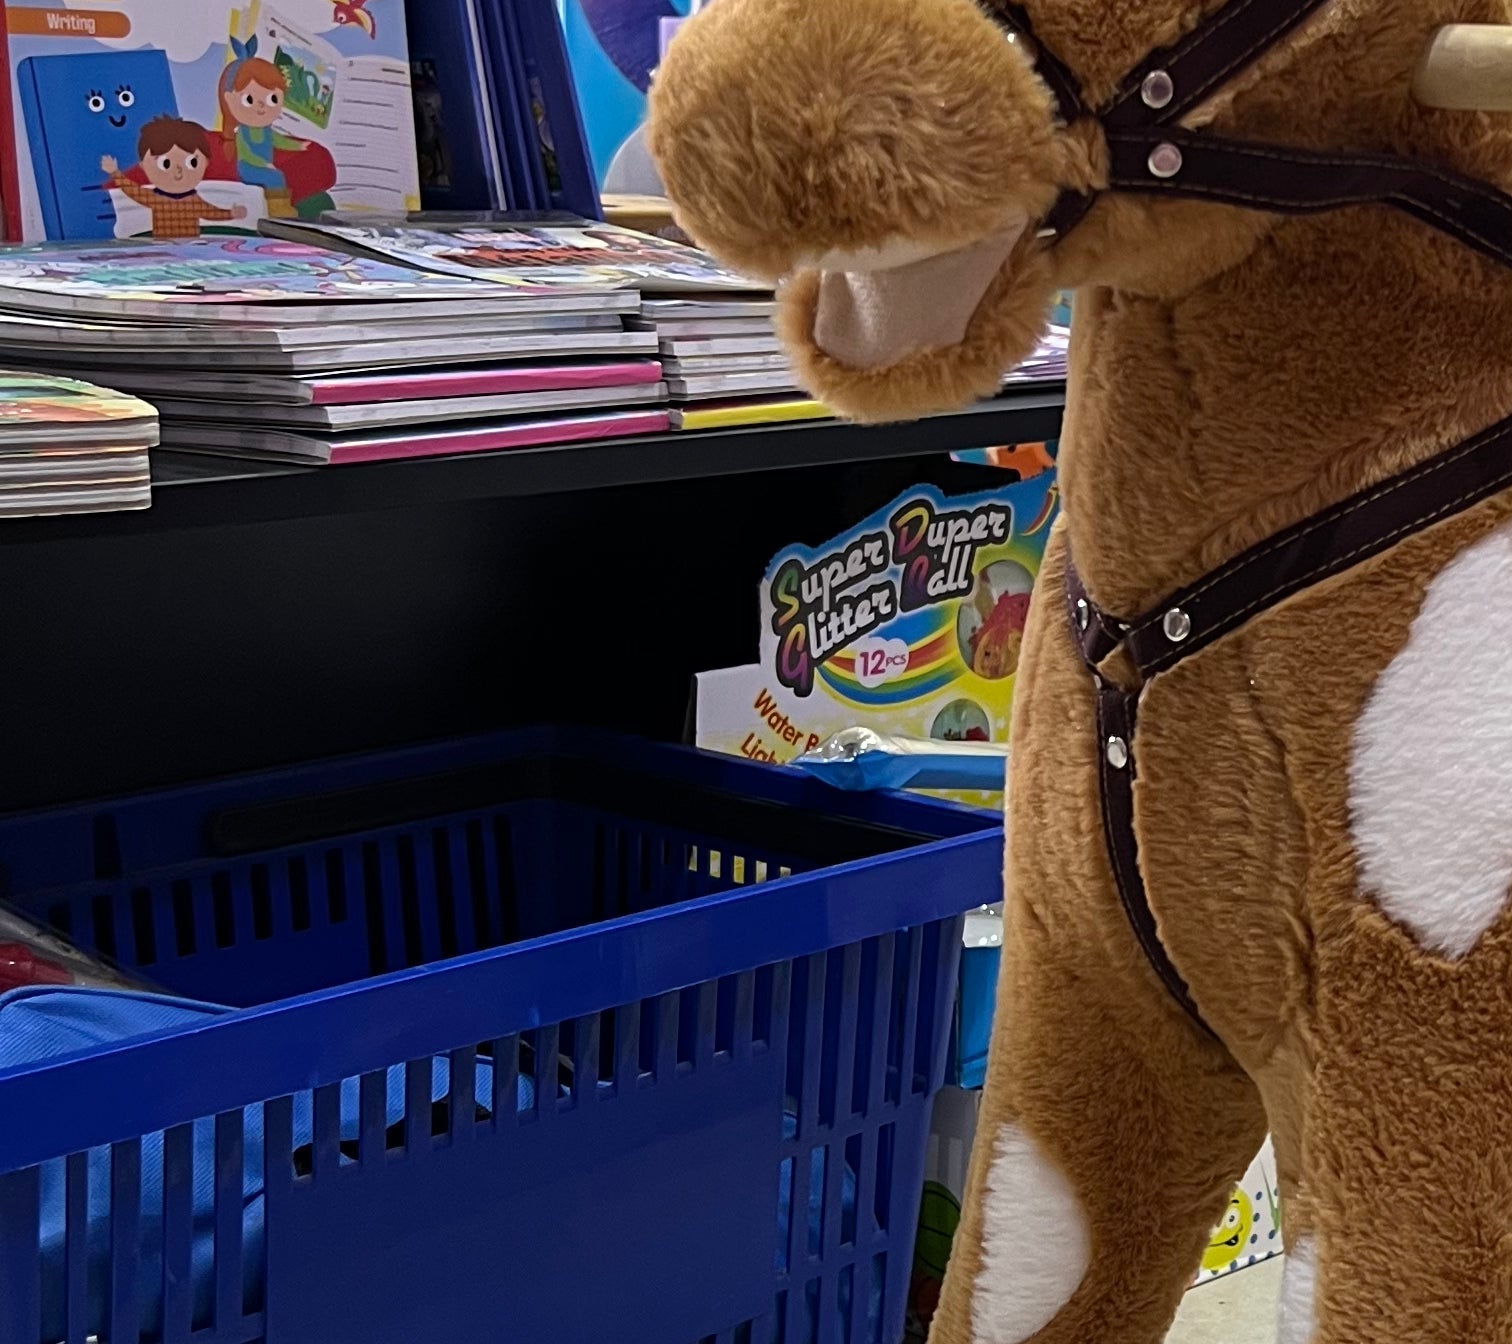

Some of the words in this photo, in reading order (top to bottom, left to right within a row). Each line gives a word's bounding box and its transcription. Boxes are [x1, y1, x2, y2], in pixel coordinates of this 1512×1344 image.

[47, 12, 96, 34] Writing
[779, 539, 884, 624] Super
[896, 509, 1006, 561] Duper
[782, 587, 892, 682] Glitter
[754, 688, 804, 746] Water
